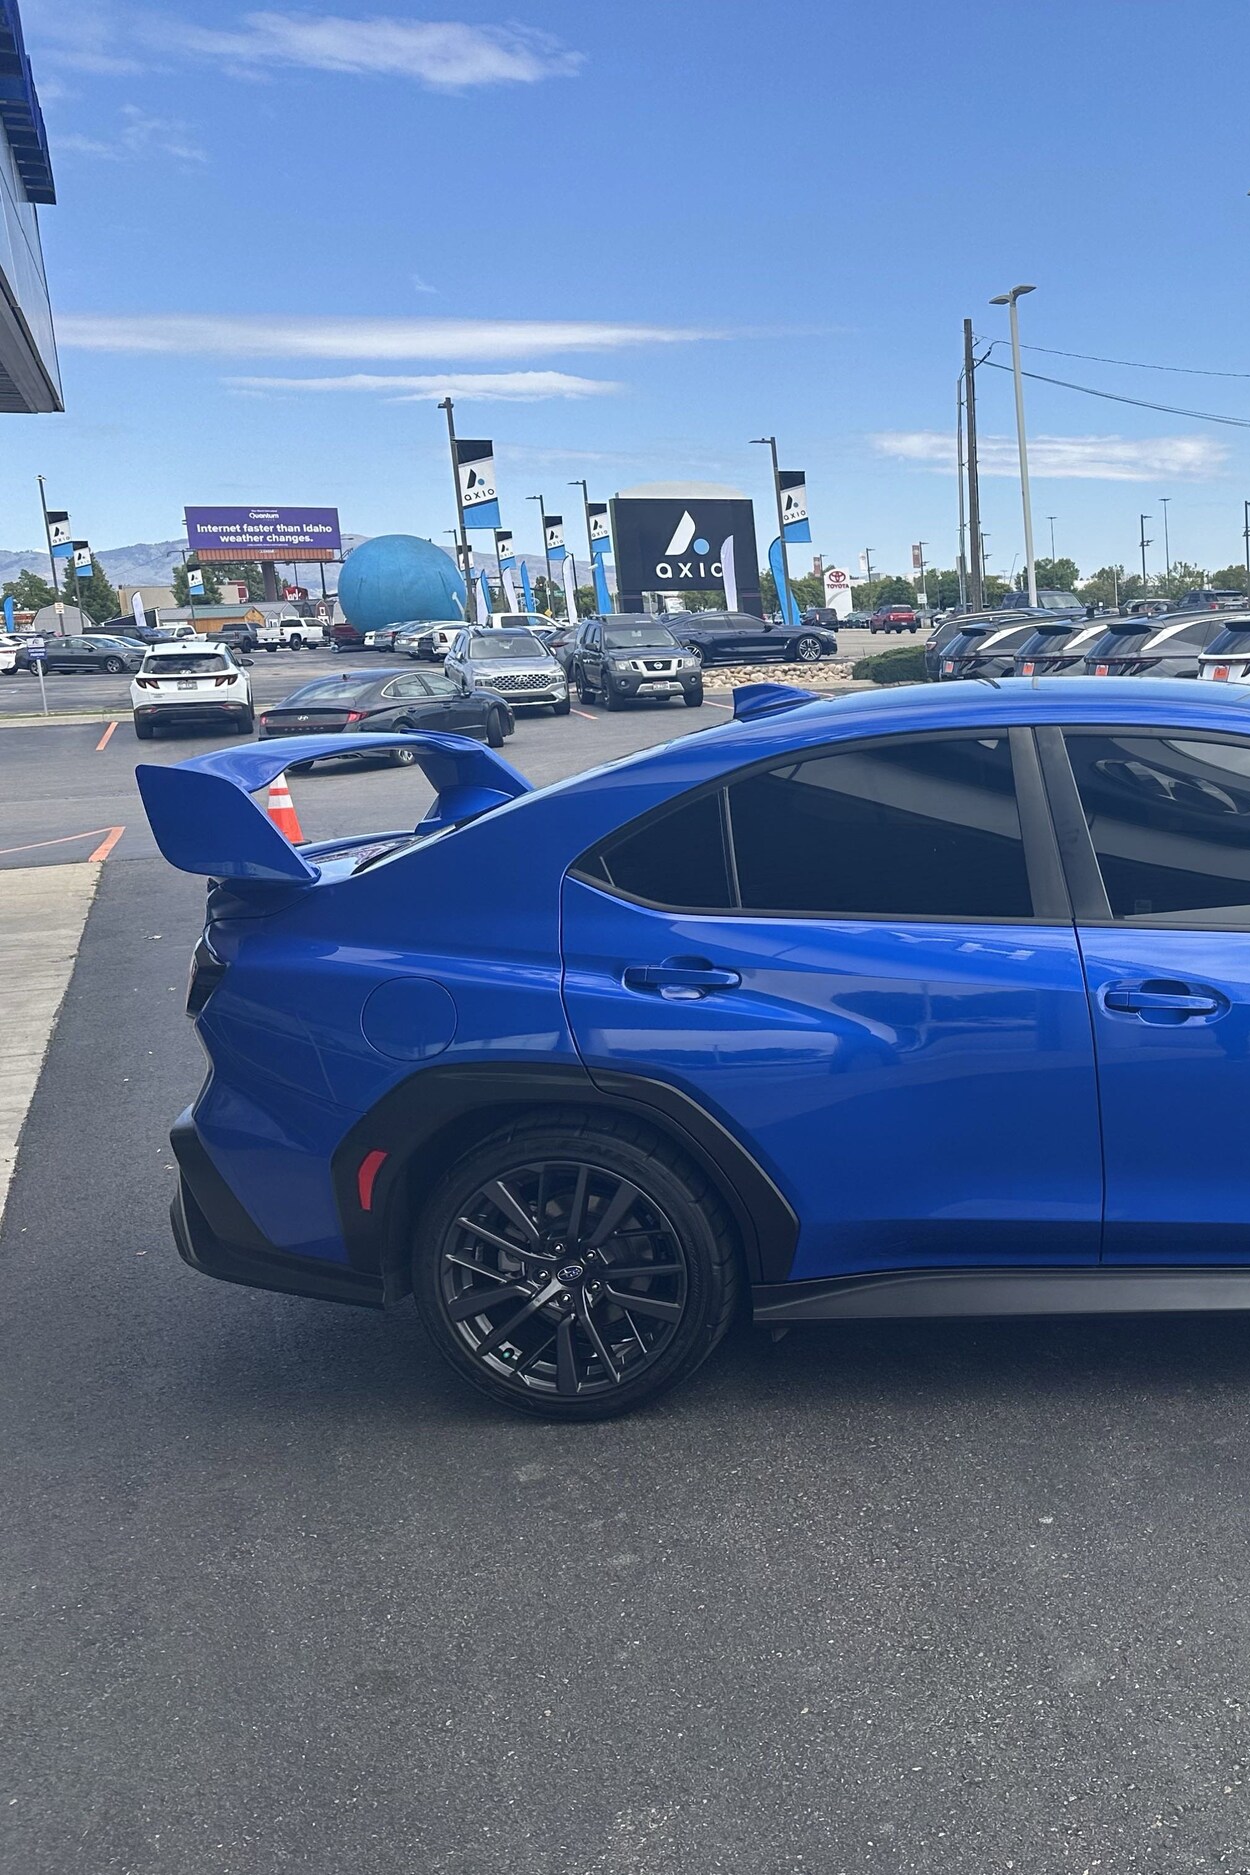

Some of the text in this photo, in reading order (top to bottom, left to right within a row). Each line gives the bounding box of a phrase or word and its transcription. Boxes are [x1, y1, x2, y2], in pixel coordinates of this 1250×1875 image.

[464, 488, 495, 501] axio
[783, 510, 807, 521] axio
[197, 523, 333, 533] Internet faster than Idaho
[219, 533, 314, 544] weather changes.
